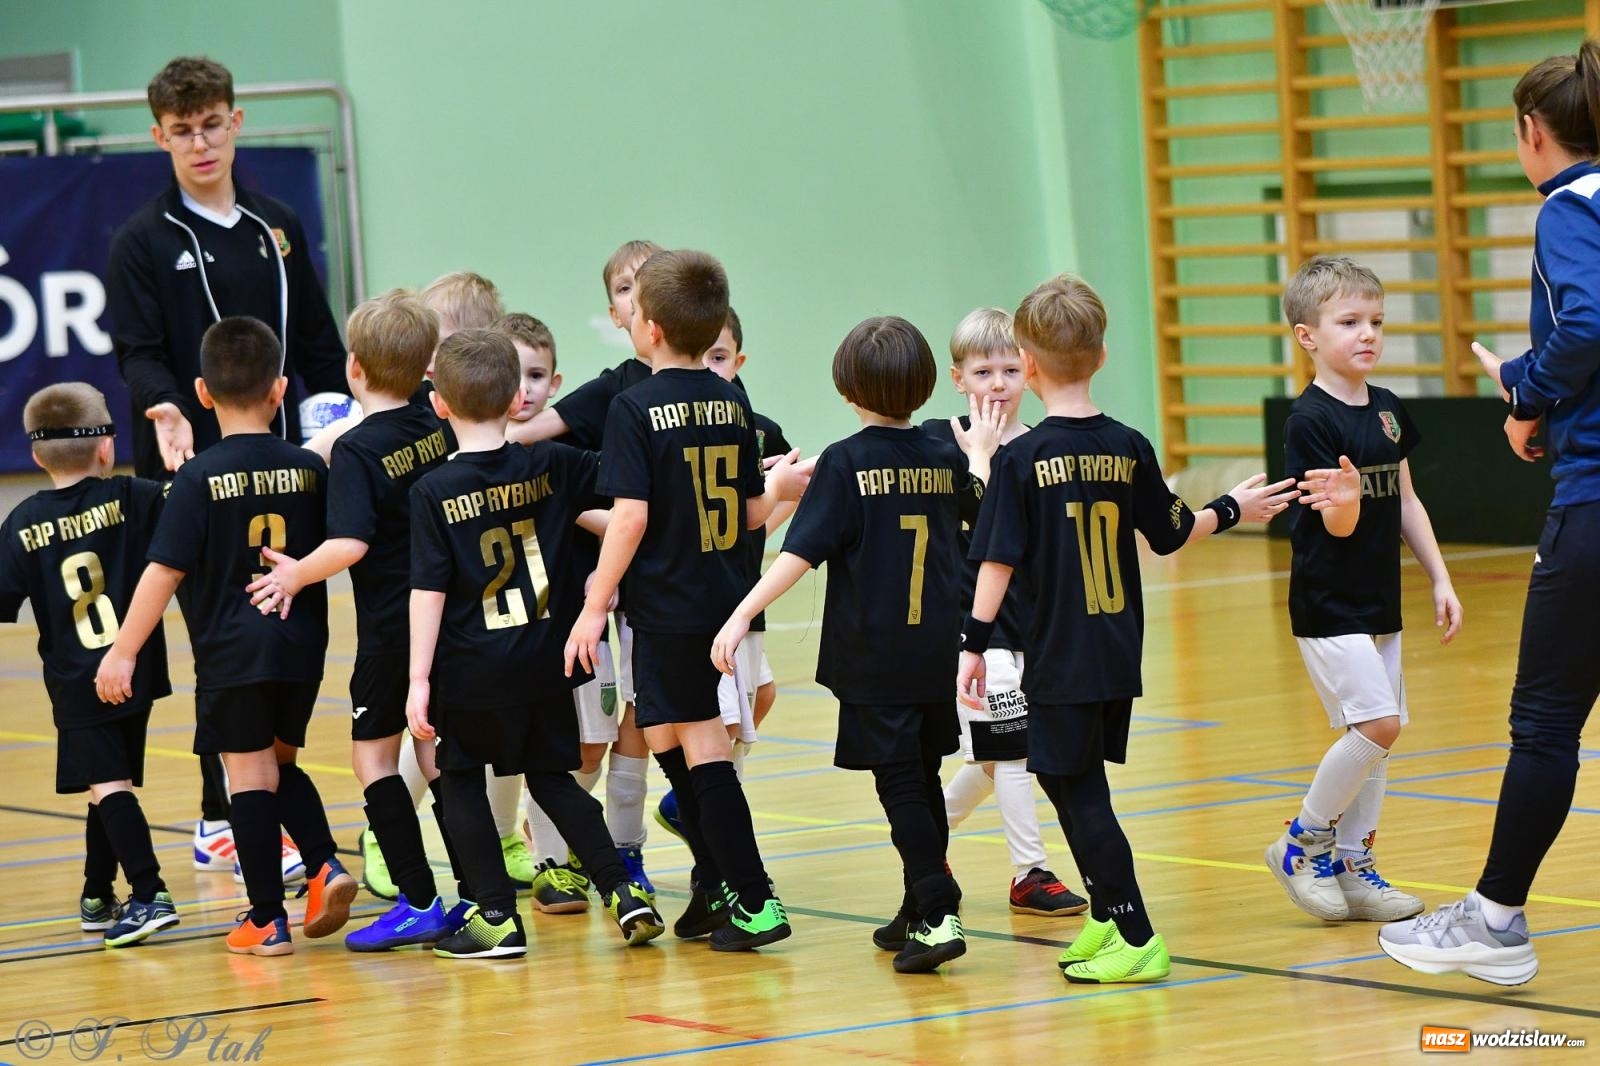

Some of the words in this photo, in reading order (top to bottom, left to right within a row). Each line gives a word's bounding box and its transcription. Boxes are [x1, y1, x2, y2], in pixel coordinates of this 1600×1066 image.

[648, 402, 690, 432] RAP
[693, 400, 748, 430] RYBNIK
[381, 446, 415, 479] RAP
[1034, 455, 1076, 488] RAP
[1079, 455, 1136, 485] RYBNIK
[208, 472, 249, 501] RAP
[442, 491, 485, 524] RAP
[486, 472, 553, 512] RYBNIK
[683, 445, 739, 552] 15
[856, 468, 895, 496] RAP
[899, 468, 953, 494] RYBNIK
[1360, 471, 1399, 499] ALK
[57, 499, 125, 541] RYBNIK
[480, 518, 550, 630] 21
[900, 515, 929, 624] 7
[1065, 501, 1125, 615] 10
[61, 551, 120, 649] 8
[987, 690, 1017, 703] EPIC
[990, 696, 1025, 711] GAME
